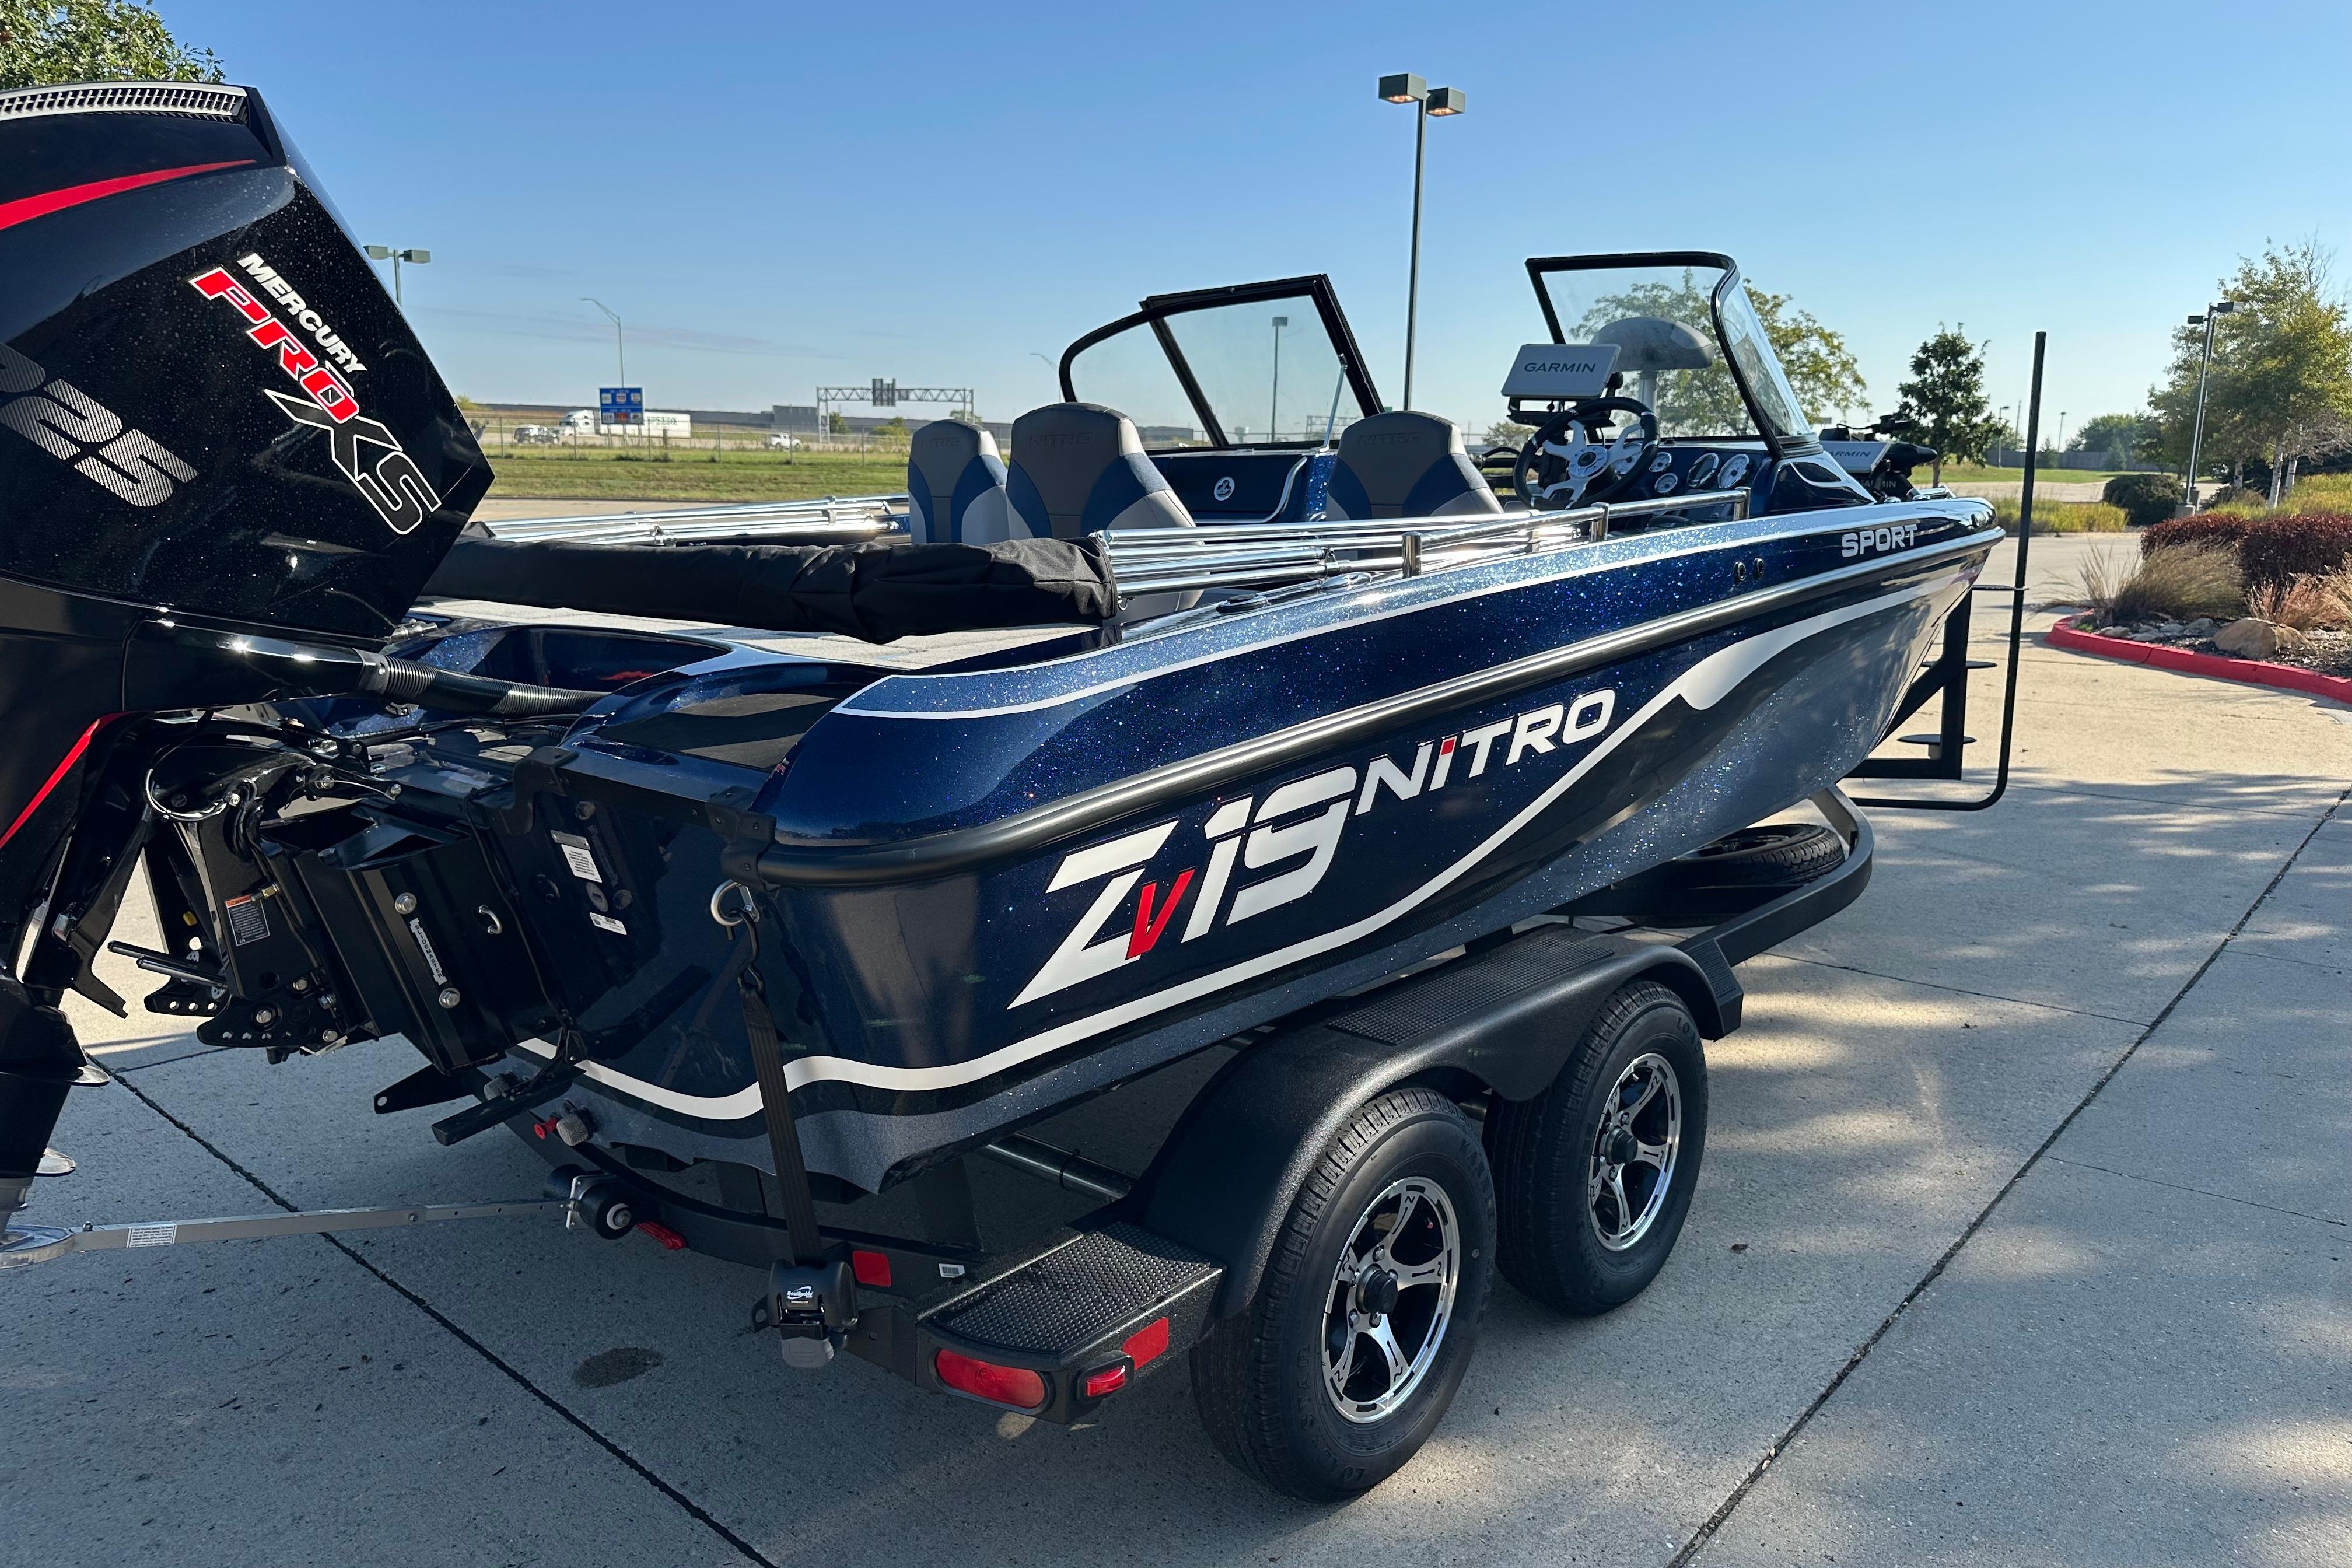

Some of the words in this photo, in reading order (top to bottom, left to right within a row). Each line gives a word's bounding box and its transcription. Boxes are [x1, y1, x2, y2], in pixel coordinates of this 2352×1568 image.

[236, 253, 367, 373] MERCURY
[188, 265, 360, 424] PRO
[1524, 362, 1595, 373] GARMIN
[0, 342, 200, 506] 25
[920, 436, 963, 449] NITRO
[1029, 431, 1095, 446] NITRO
[1358, 432, 1422, 444] NITRO
[264, 360, 442, 536] XS
[1841, 523, 1918, 558] SPORT
[415, 925, 443, 978] SLIDEMASTER
